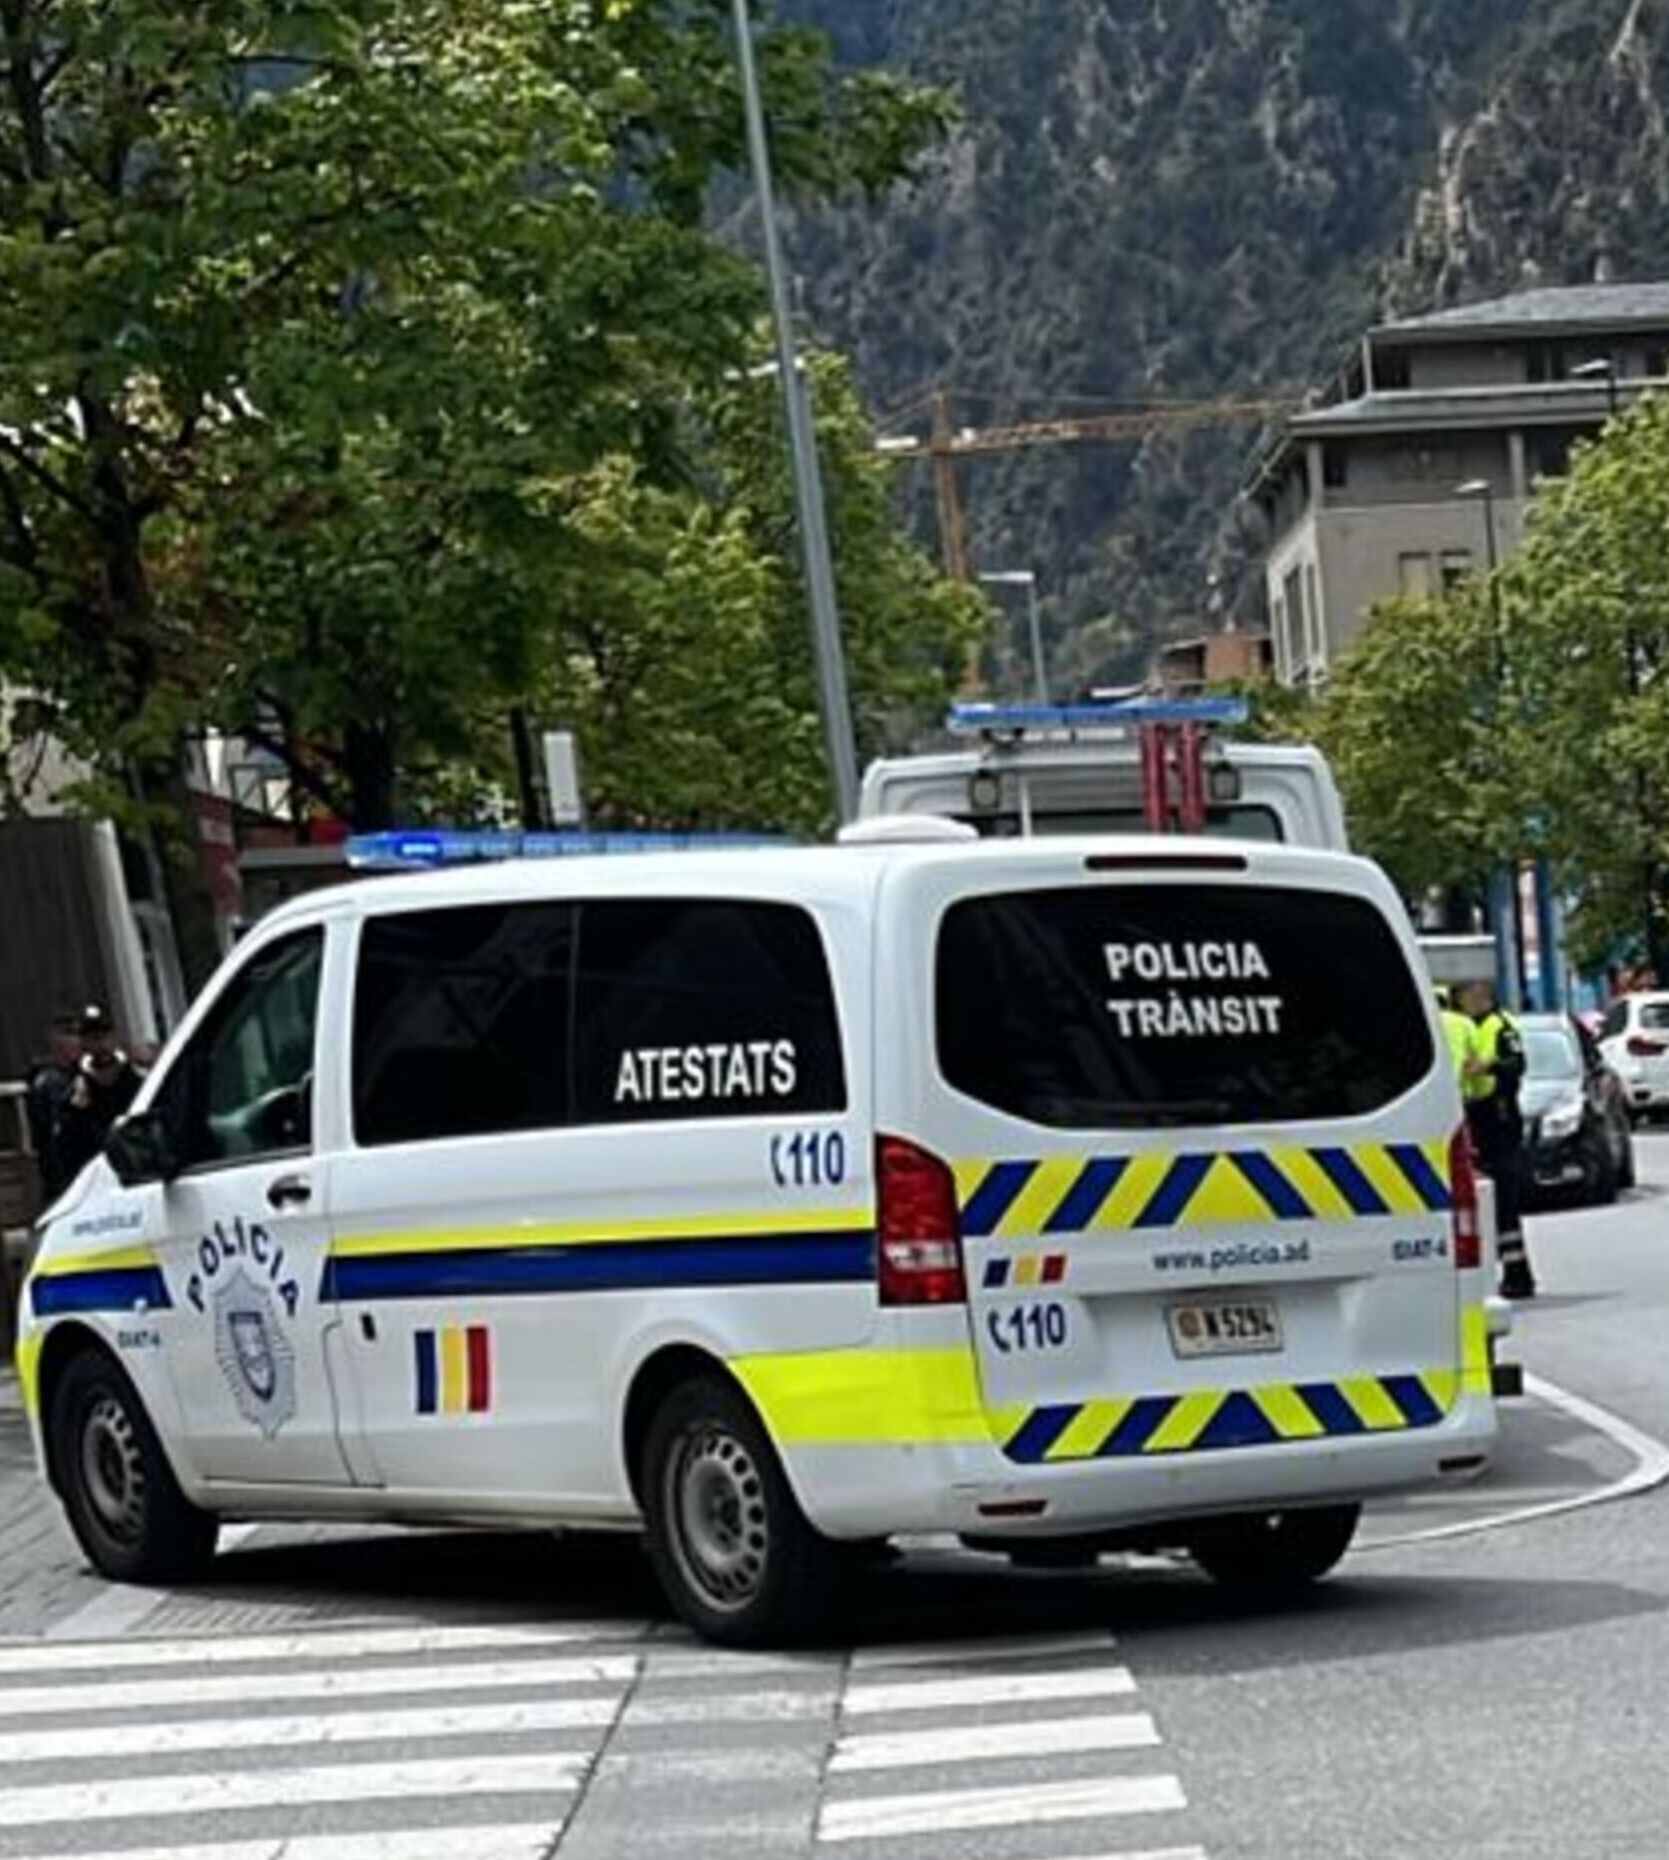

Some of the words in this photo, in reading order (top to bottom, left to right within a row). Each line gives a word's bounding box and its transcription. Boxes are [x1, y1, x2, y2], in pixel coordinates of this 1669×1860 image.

[1103, 941, 1270, 981] POLICIA
[1107, 990, 1281, 1036] TRÀNSIT
[615, 1039, 796, 1101] ATESTATS
[788, 1131, 844, 1186] 110
[186, 1216, 299, 1317] POLICIA
[1153, 1241, 1310, 1270] www.policia.ad
[1009, 1303, 1066, 1349] 110
